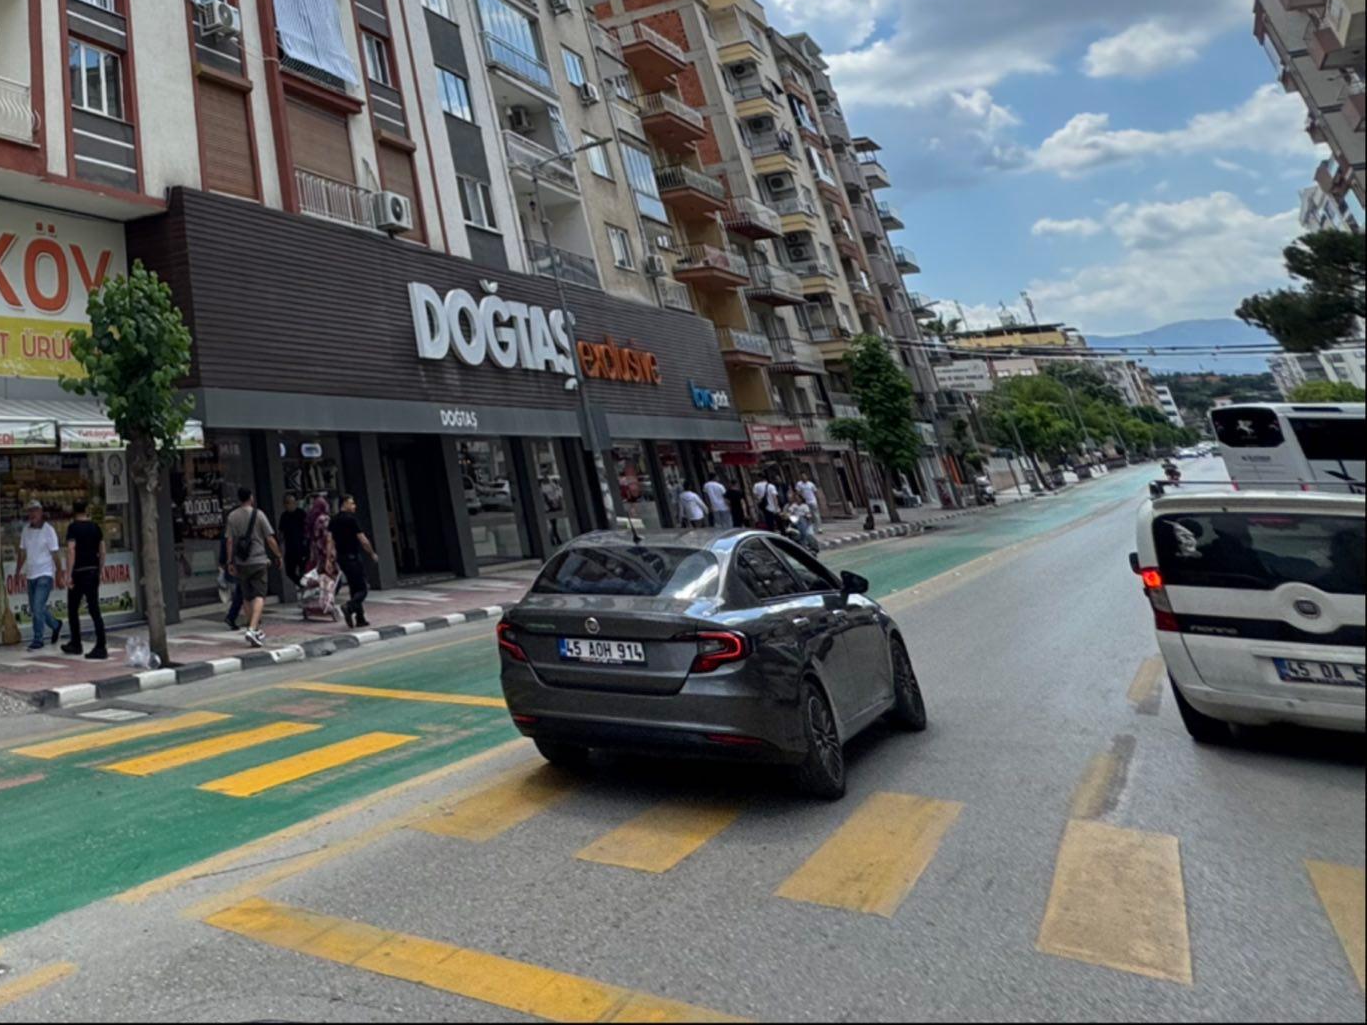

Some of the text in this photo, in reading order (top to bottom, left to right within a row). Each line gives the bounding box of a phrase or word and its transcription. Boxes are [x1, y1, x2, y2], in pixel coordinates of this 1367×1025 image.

[407, 279, 576, 390] DOĞTAŞ
[441, 408, 478, 430] DOĞTAŞ
[101, 564, 131, 584] ANDIRA
[566, 640, 582, 656] 45
[617, 643, 643, 659] 914
